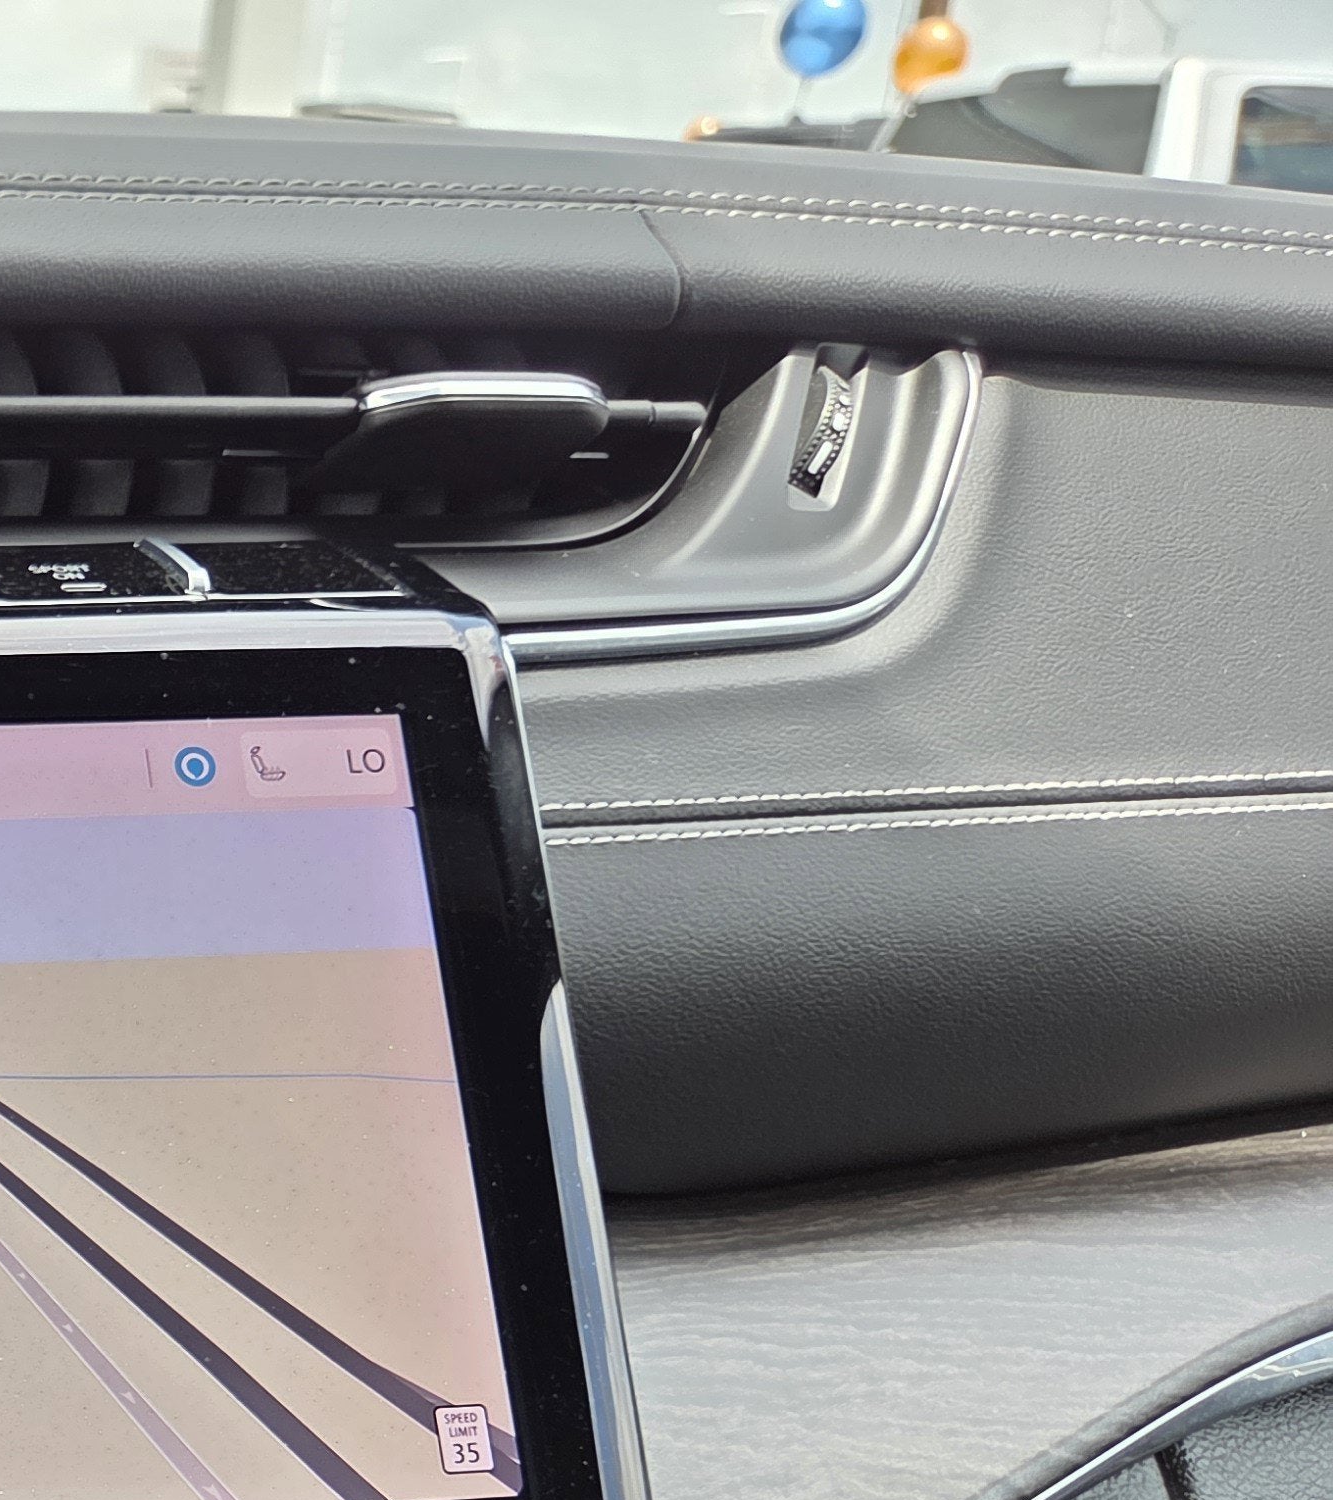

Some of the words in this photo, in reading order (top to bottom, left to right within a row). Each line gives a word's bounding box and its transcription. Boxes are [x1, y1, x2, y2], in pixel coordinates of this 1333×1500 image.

[346, 748, 386, 774] LO
[443, 1412, 478, 1424] SPEED
[448, 1426, 477, 1438] LIMIT
[452, 1442, 480, 1464] 35
